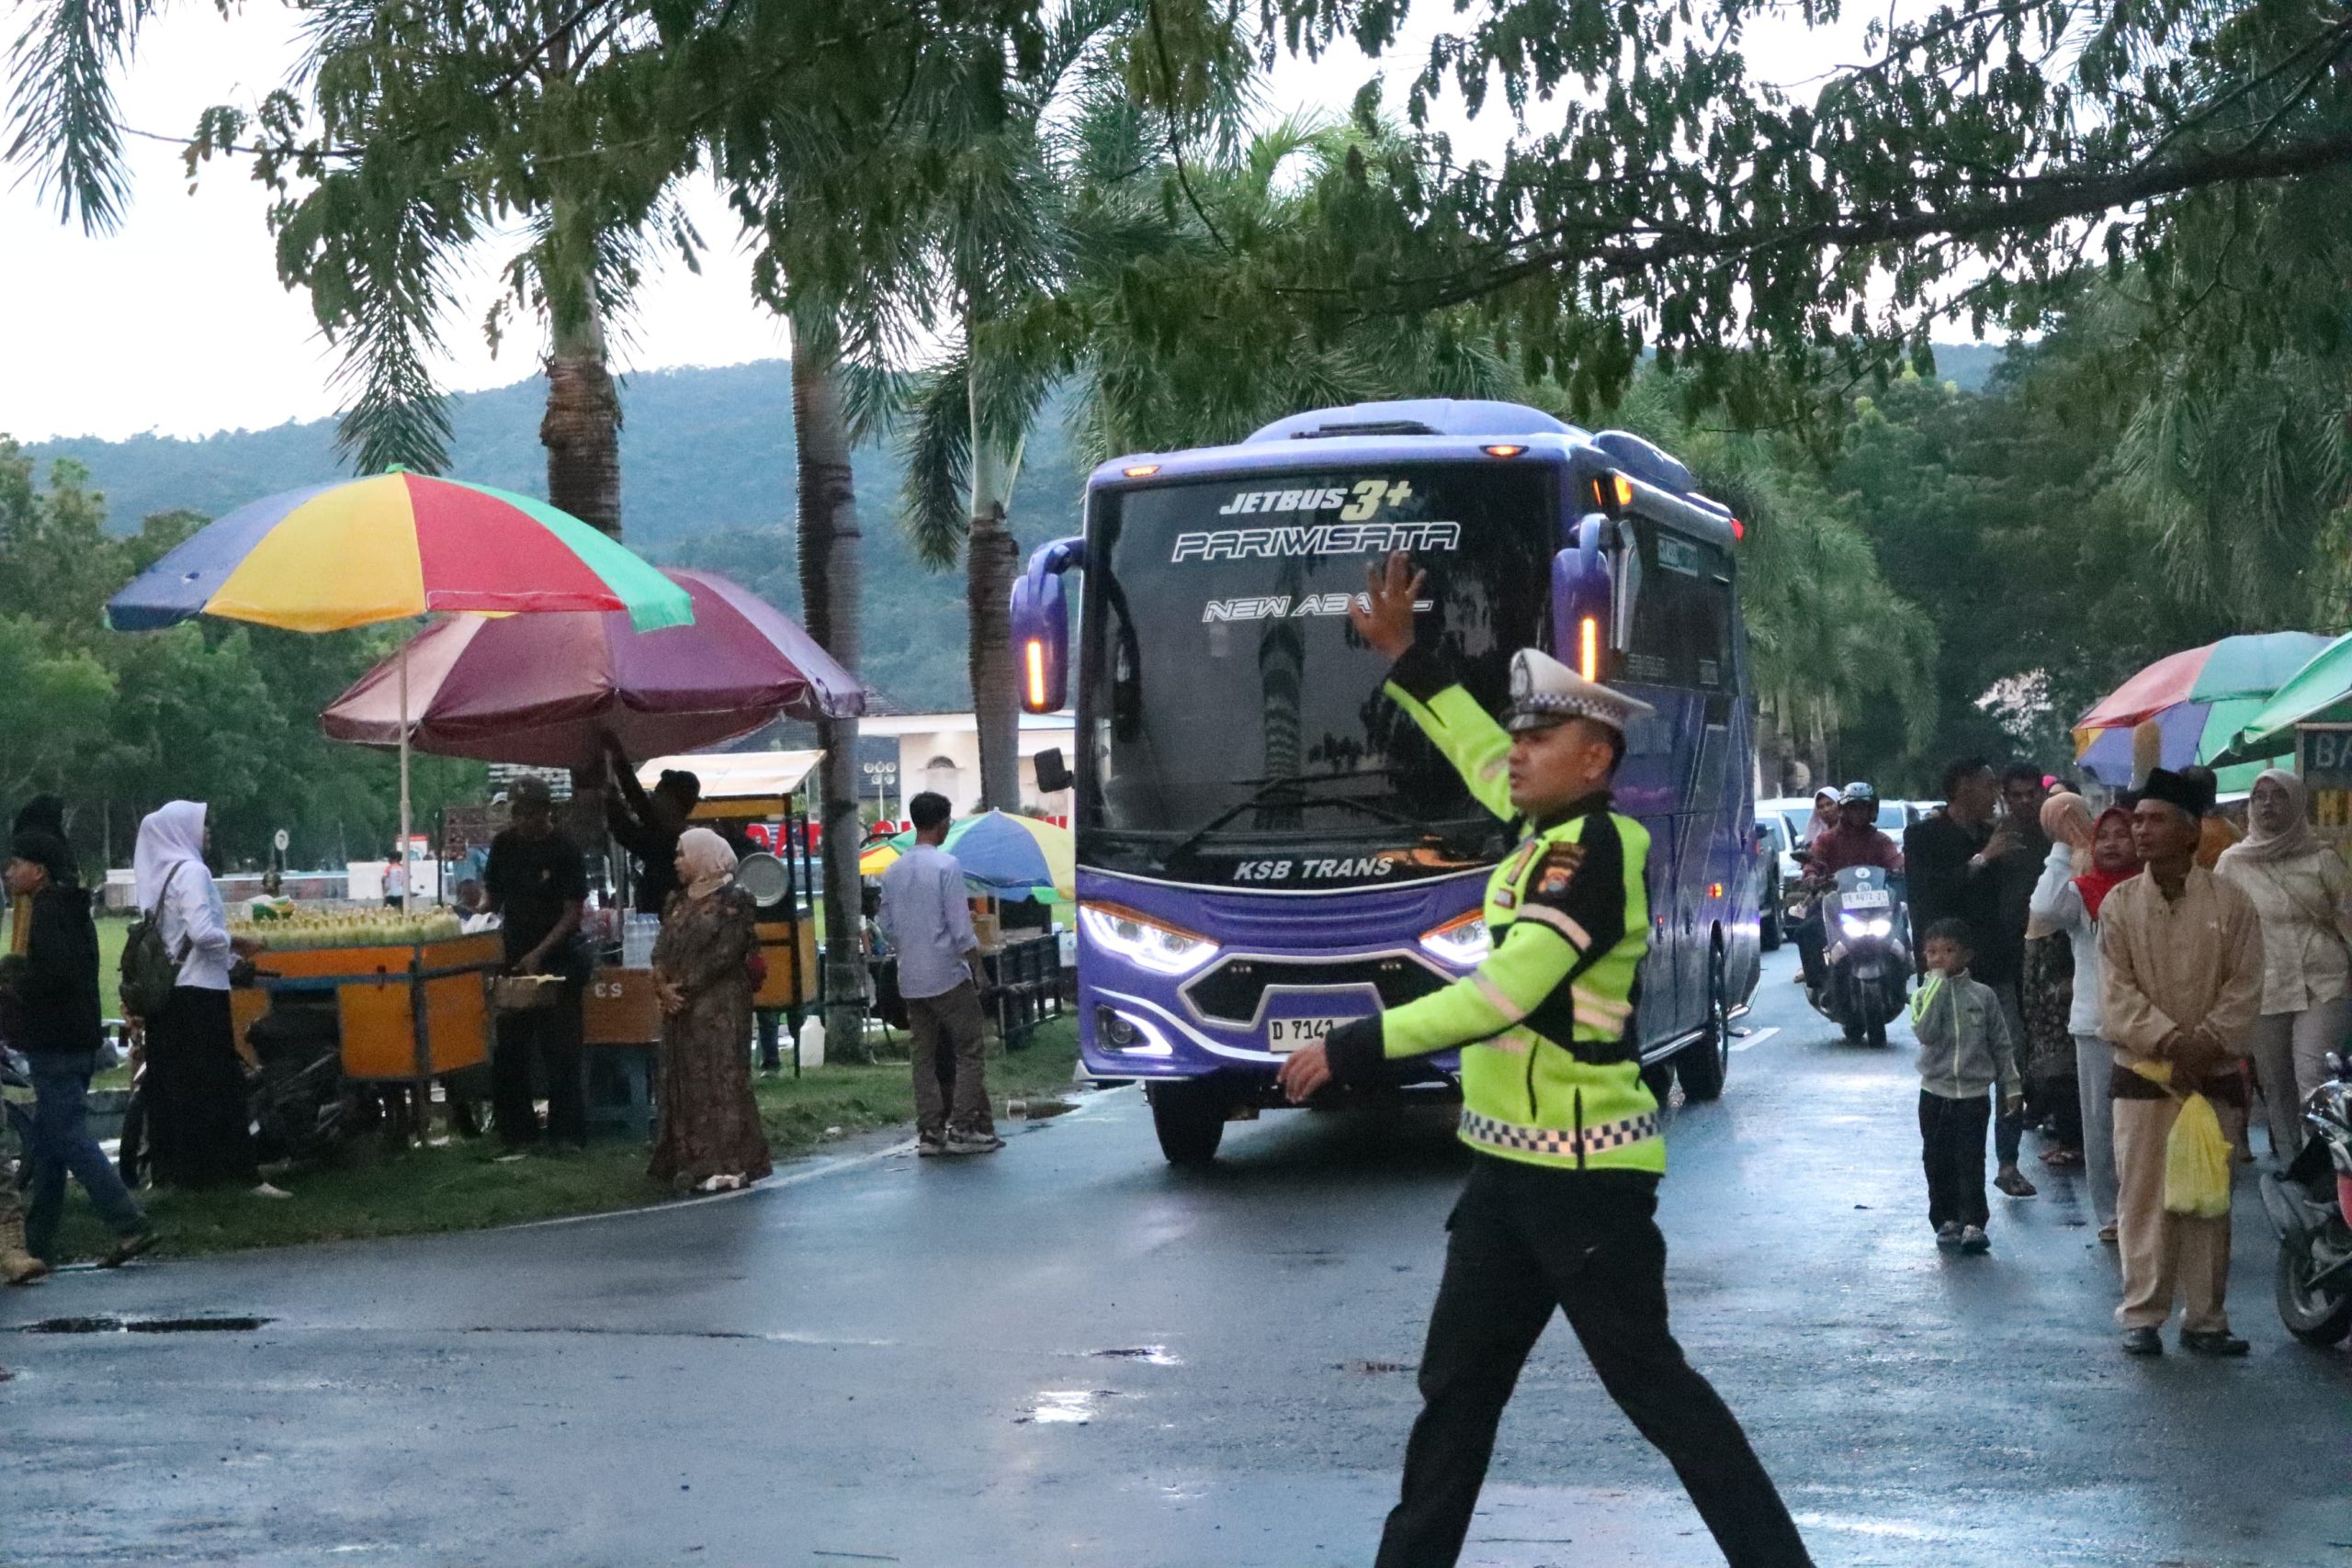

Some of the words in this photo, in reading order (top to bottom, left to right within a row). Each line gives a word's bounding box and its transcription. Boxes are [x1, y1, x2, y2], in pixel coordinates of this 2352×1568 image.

[1219, 488, 1348, 515] JETBUS
[1171, 521, 1461, 562] PARIWISATA
[1202, 595, 1291, 623] NEW
[1234, 861, 1292, 880] KSB
[1302, 857, 1394, 878] TRANS
